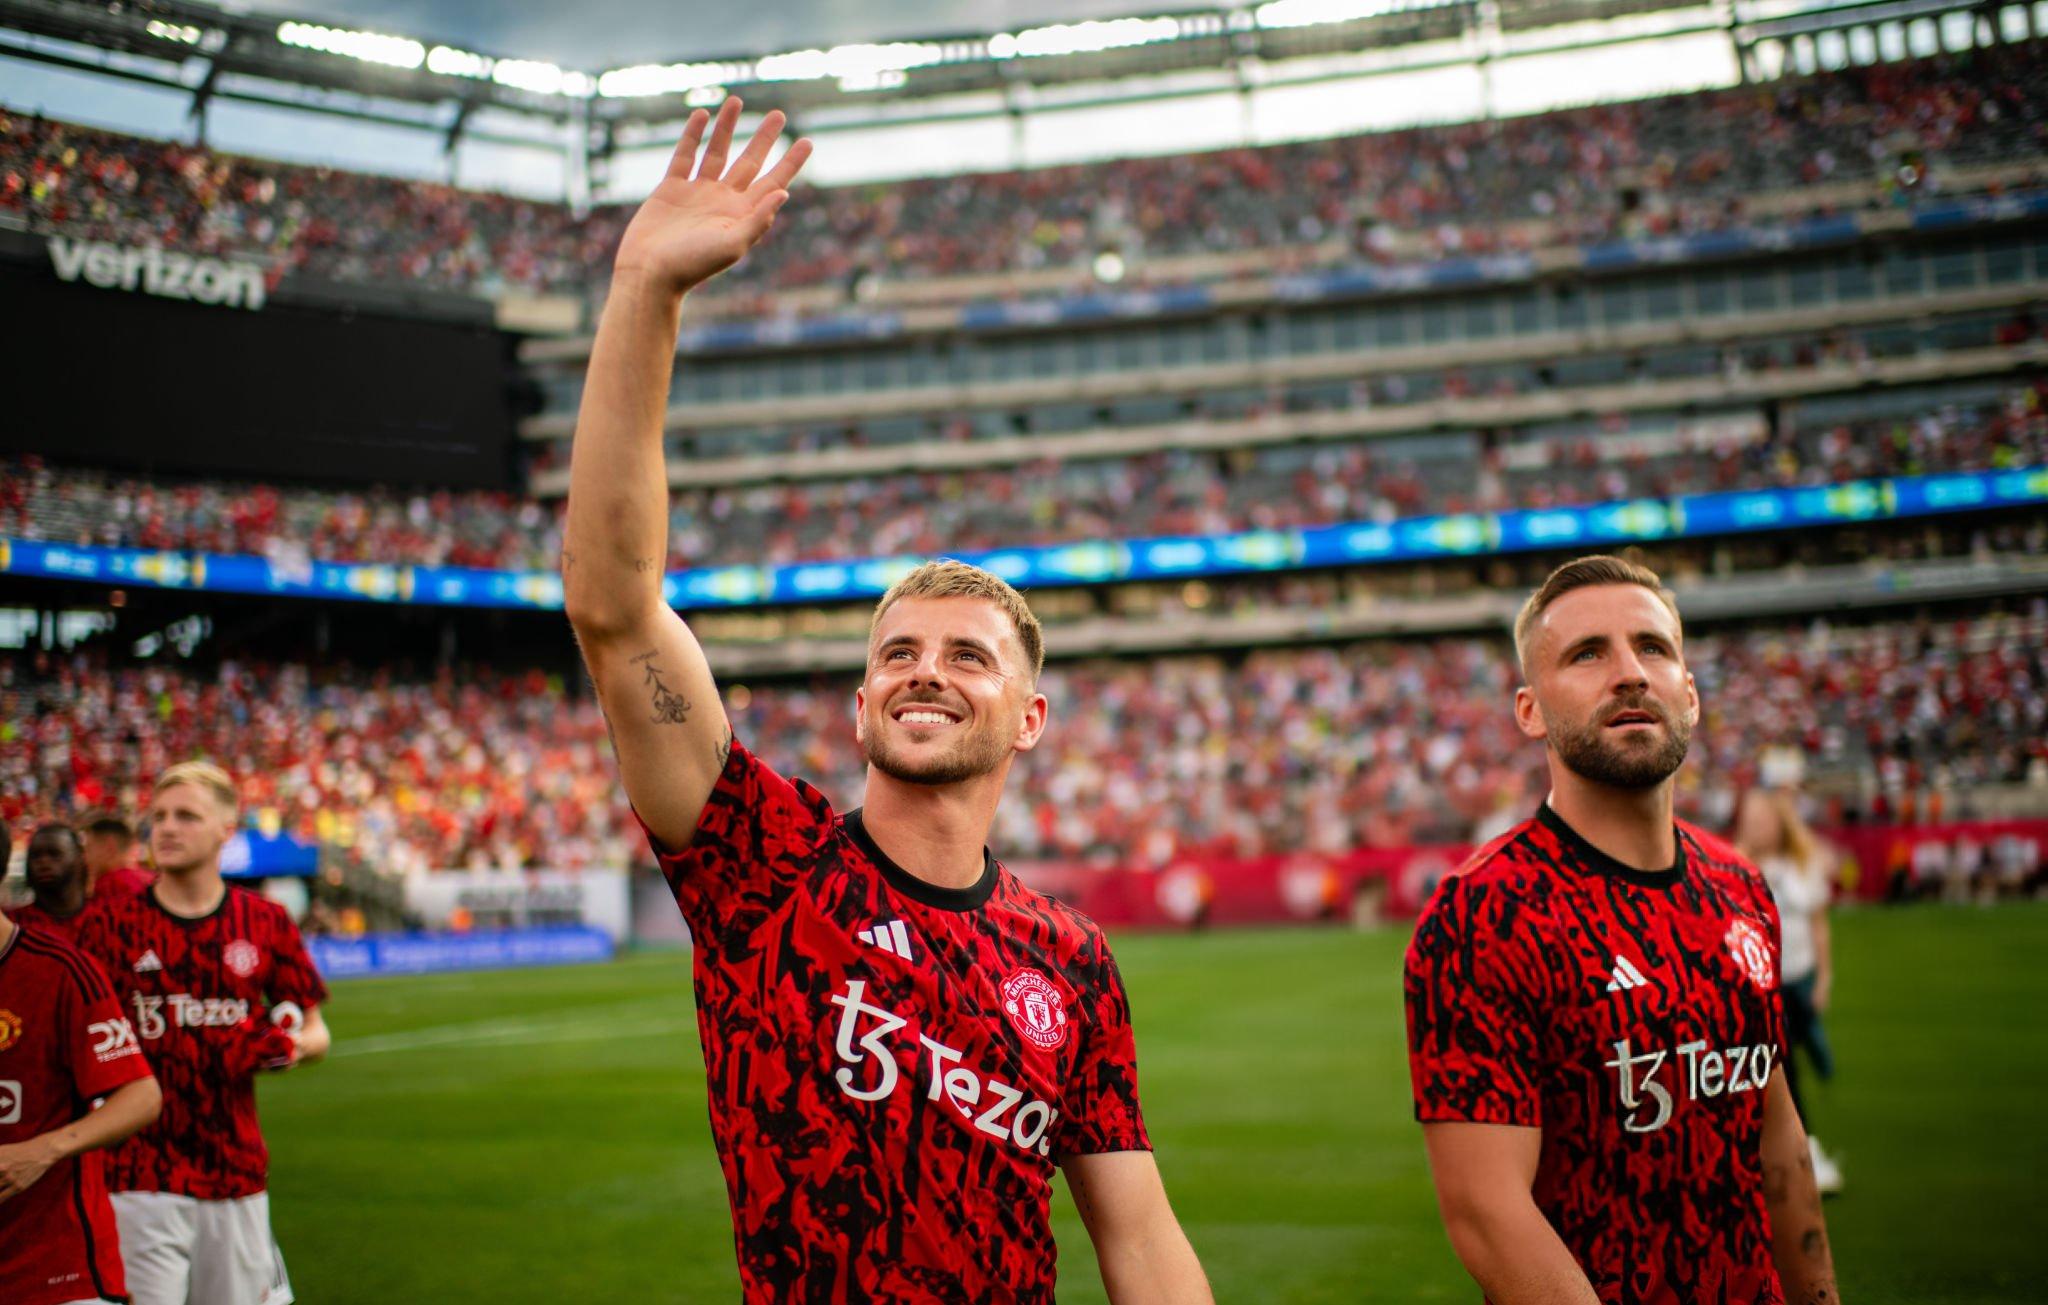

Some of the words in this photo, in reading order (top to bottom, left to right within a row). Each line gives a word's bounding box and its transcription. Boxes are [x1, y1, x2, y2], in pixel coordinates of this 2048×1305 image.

[47, 233, 266, 311] verizon
[1009, 977, 1060, 1006] MANCHESTER
[1025, 1025, 1059, 1042] UNITED
[1676, 1039, 1778, 1101] Tezo
